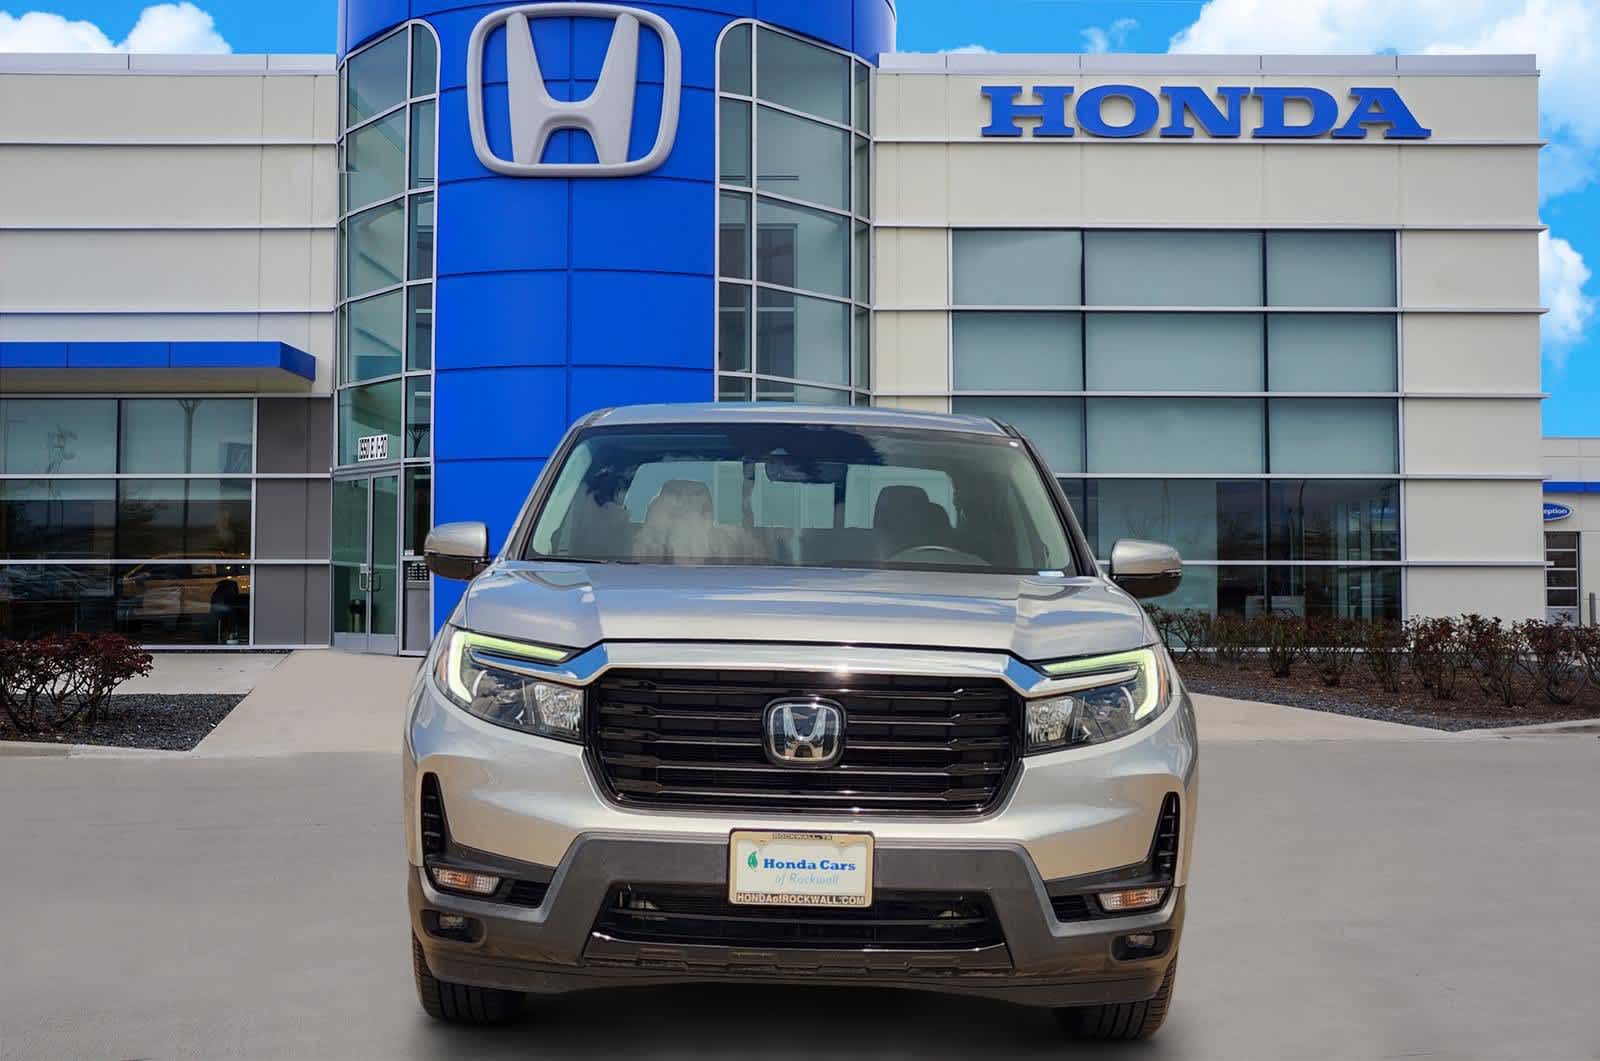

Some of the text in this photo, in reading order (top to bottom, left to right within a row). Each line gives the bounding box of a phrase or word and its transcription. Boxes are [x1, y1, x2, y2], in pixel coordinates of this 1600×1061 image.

[981, 84, 1431, 139] HONDA
[764, 858, 856, 871] Honda Cars
[776, 873, 839, 886] of Rockwall
